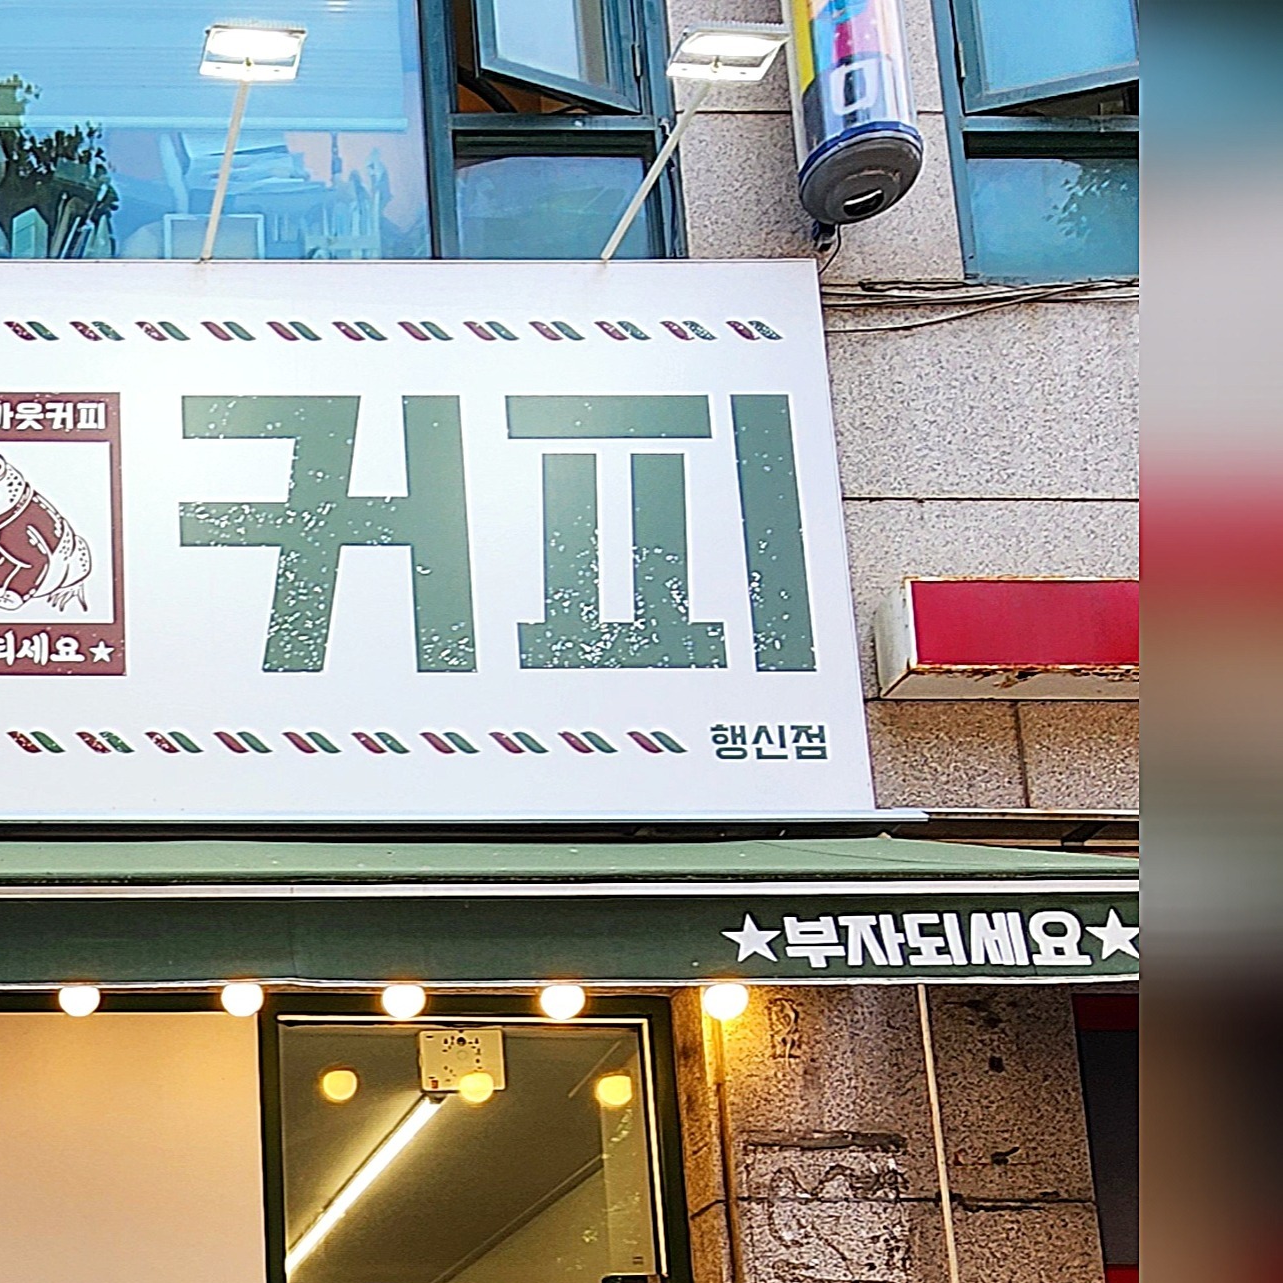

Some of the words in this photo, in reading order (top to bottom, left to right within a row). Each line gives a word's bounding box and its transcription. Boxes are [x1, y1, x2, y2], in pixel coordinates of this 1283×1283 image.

[179, 395, 817, 673] 커피
[711, 724, 828, 760] 행신점
[782, 910, 1093, 968] 부자되세요
